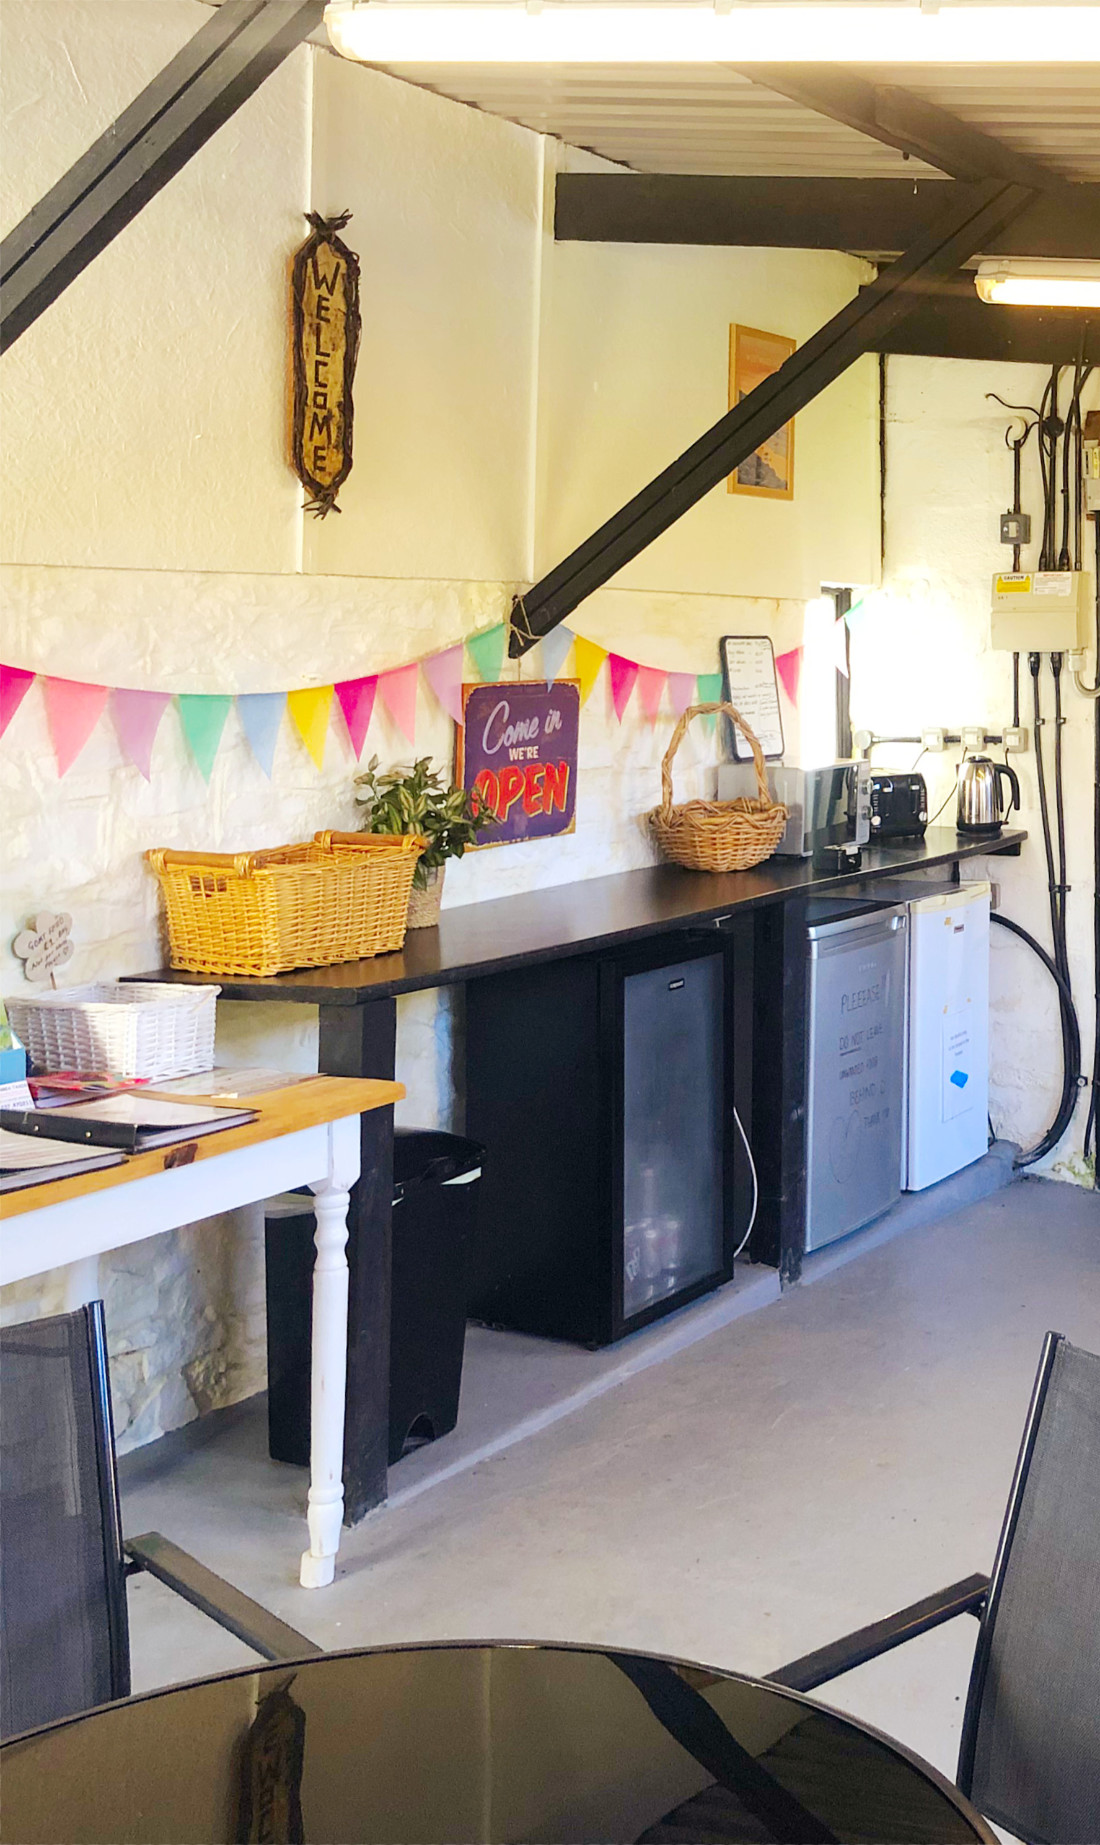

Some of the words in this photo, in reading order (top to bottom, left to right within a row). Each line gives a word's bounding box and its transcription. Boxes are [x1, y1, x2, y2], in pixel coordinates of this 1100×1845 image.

[309, 257, 341, 472] WELCOME
[483, 701, 540, 754] Come
[544, 709, 562, 734] in
[508, 746, 540, 761] WE'RE
[472, 761, 570, 822] OPEN
